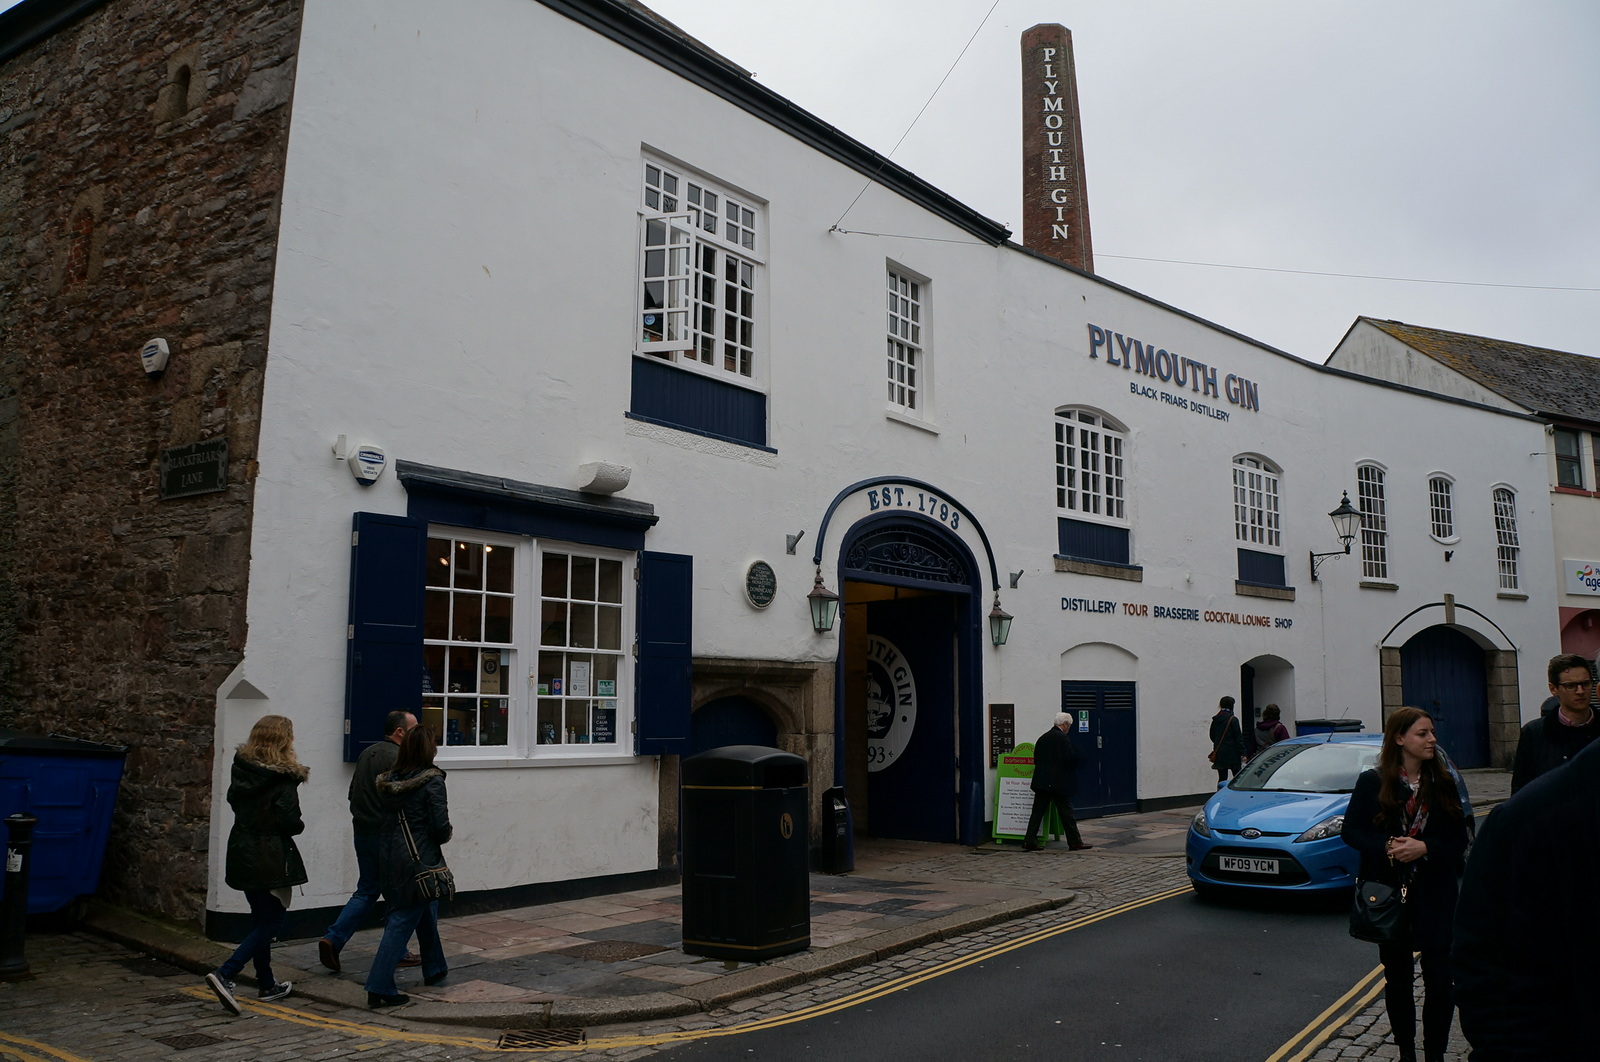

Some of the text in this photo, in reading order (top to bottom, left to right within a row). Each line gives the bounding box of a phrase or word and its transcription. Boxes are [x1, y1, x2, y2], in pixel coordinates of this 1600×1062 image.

[1043, 47, 1069, 240] PLYMOUTH GIN
[1087, 322, 1260, 412] PLYMOUTH GIN
[1130, 382, 1231, 423] BLACK FRIARS DISTILLERY
[168, 450, 222, 471] BLACKFRIARS
[181, 472, 204, 488] LANE
[867, 486, 960, 531] EST. 1793
[1061, 597, 1293, 630] DISTILLERY TOUR BRASSERIE COCKTAIL LOUNGE SHOP
[893, 666, 913, 706] GIN
[1224, 857, 1274, 872] WF09 YCM
